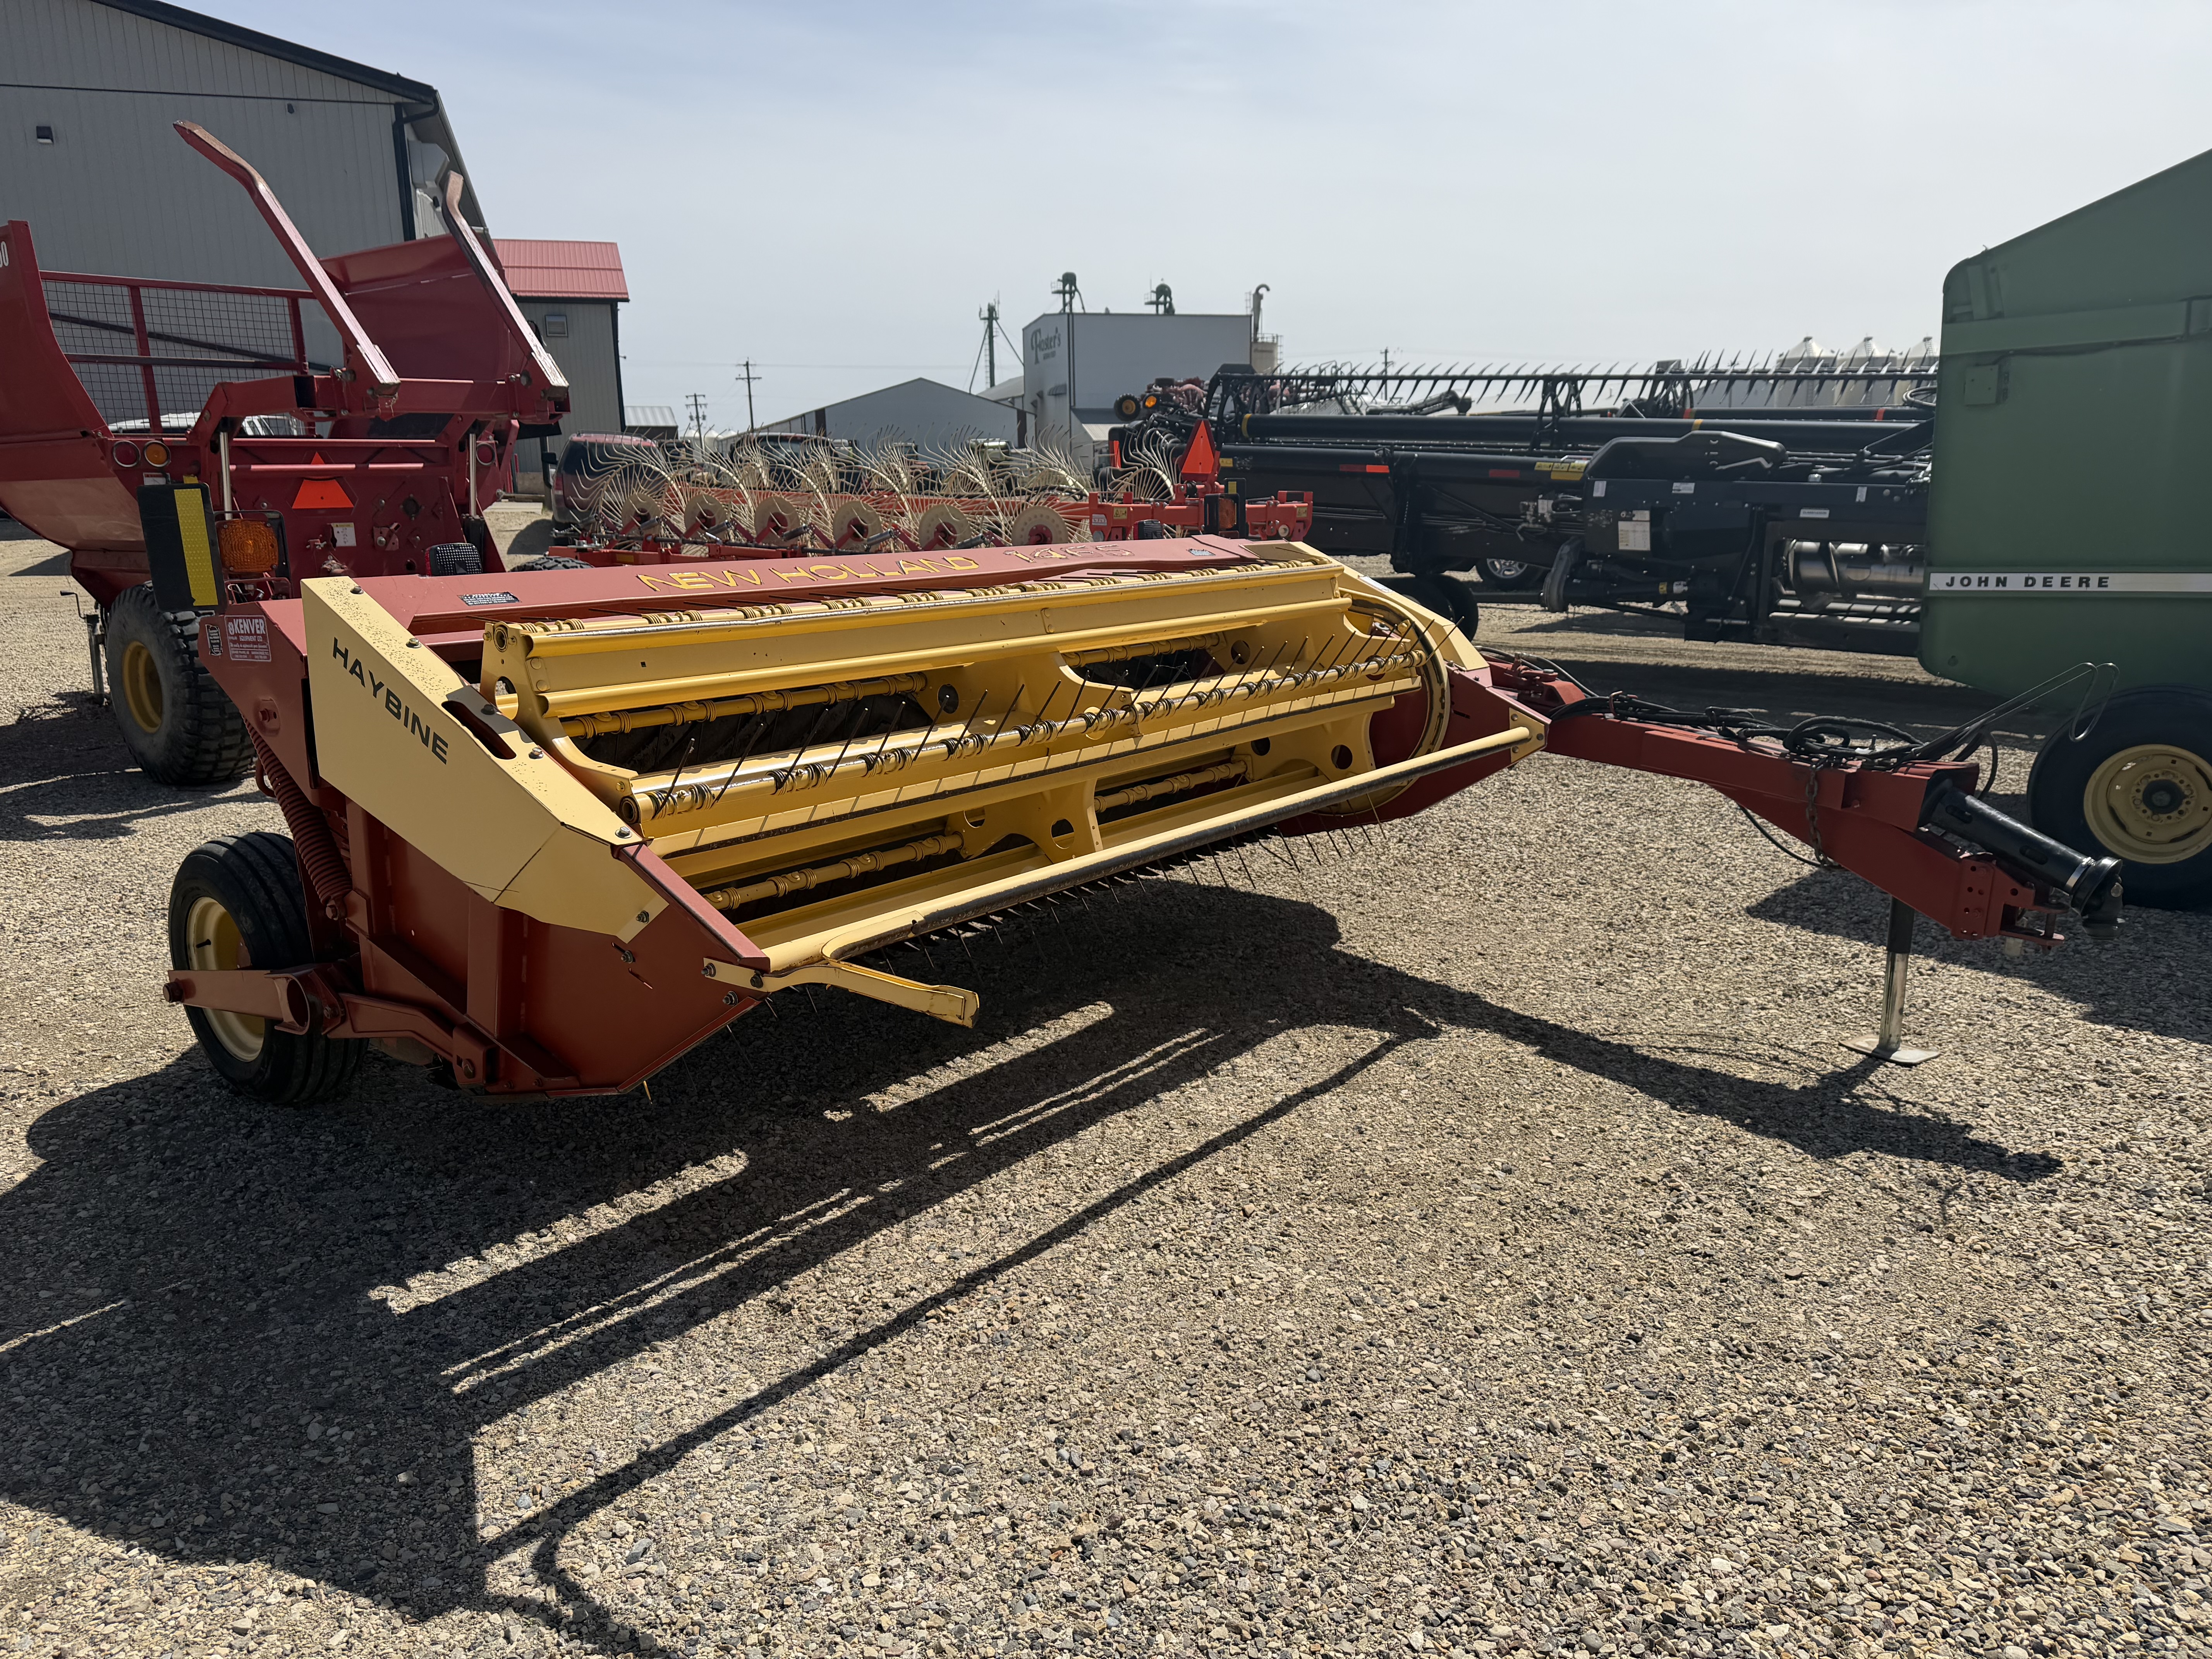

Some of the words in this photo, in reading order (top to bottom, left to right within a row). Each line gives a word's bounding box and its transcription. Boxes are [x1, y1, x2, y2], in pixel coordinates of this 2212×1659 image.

[1003, 544, 1135, 563] 1465
[635, 569, 764, 591] NEW
[769, 556, 979, 583] HOLLAND
[1946, 576, 2008, 587] JOHN
[2024, 576, 2109, 588] DEERE
[233, 618, 266, 634] KENVER
[333, 637, 448, 765] HAYBINE
